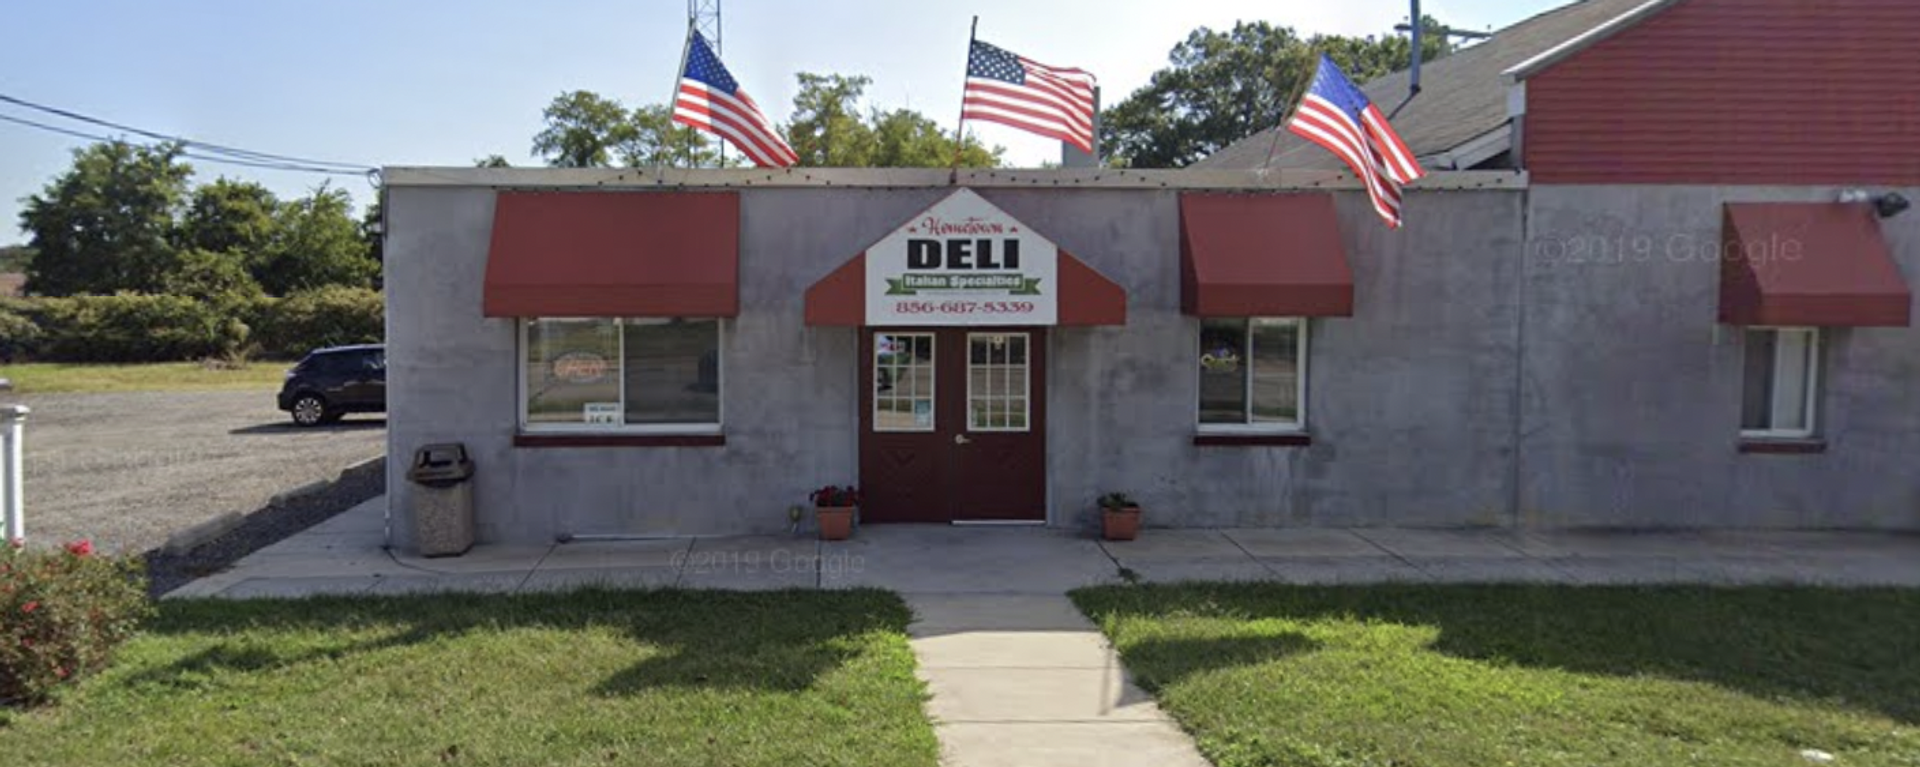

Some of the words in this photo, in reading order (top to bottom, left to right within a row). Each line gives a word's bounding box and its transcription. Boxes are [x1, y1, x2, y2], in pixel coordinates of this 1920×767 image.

[921, 216, 1004, 236] Hometown
[907, 239, 1020, 270] DELI
[905, 275, 947, 287] Italian
[950, 275, 1021, 289] Specialties
[896, 301, 1034, 313] 856-687-5339
